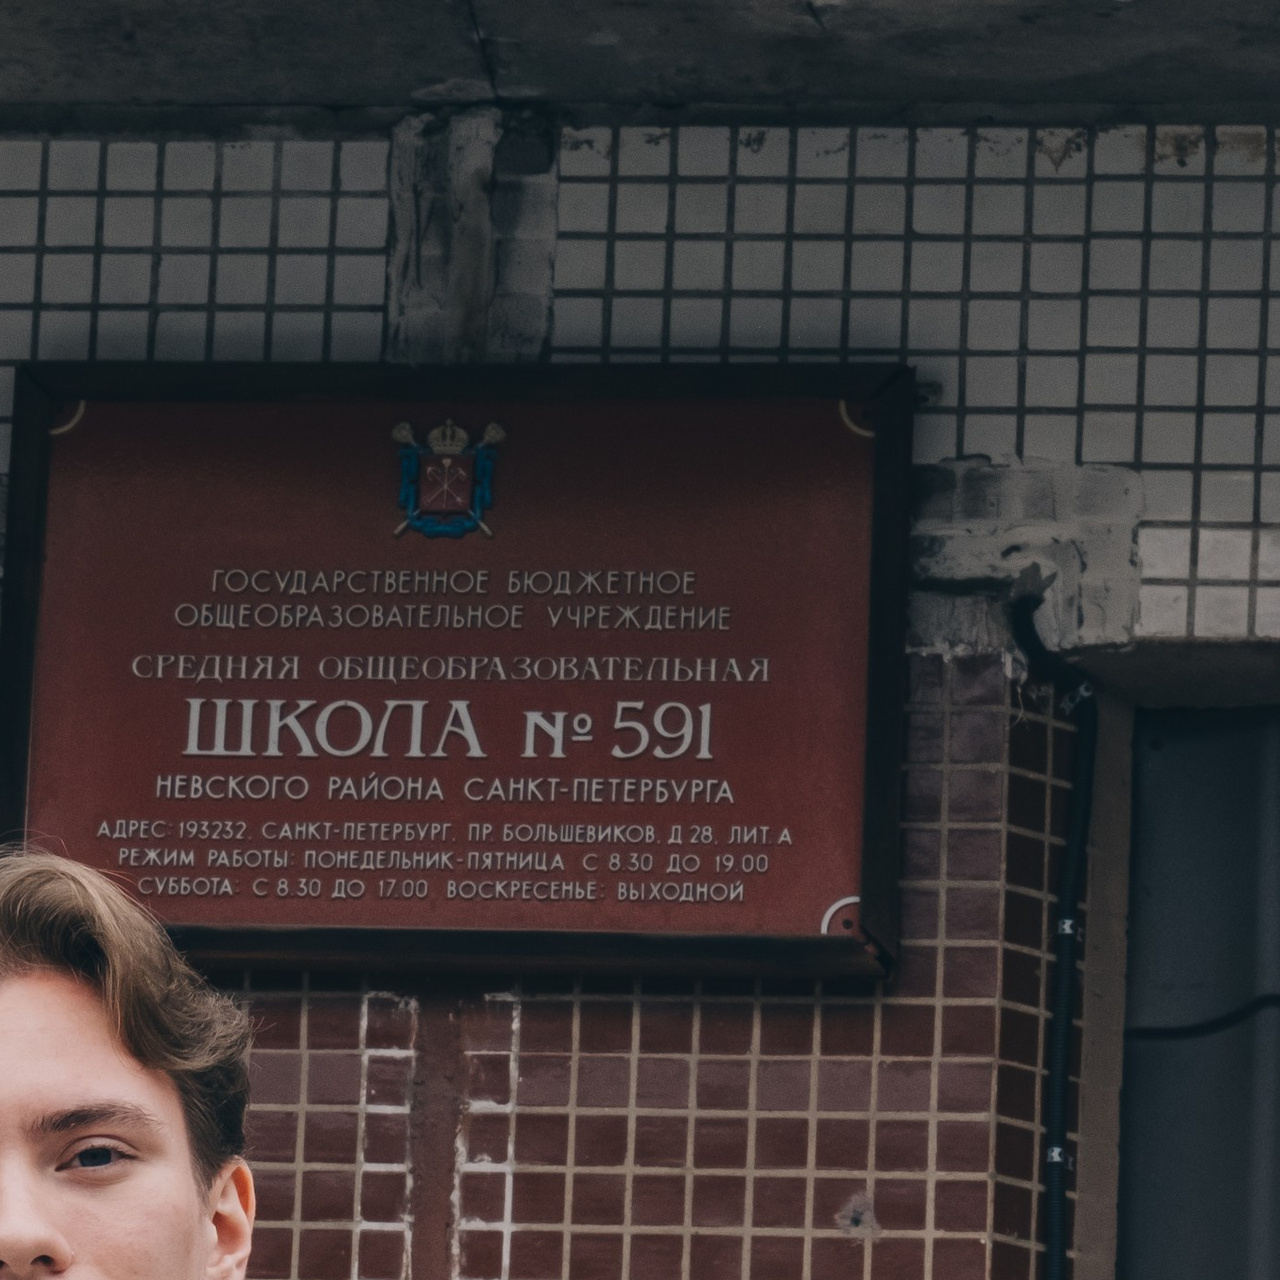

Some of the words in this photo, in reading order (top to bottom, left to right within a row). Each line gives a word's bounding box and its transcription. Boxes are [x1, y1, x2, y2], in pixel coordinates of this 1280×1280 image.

[211, 569, 489, 595] ГОСУДАРСТВЕННОЕ
[507, 570, 696, 595] БЮДЖЕТНОЕ
[175, 603, 524, 630] ОБЩЕОБРАЗОВАТЕЛЬНОЕ
[547, 604, 731, 631] УЧРЕЖДЕНИЕ
[131, 655, 300, 684] СРЕДНЯЯ
[318, 656, 771, 684] ОБЩЕОБРАЗОВАТЕЛЬНАЯ
[182, 698, 488, 758] ШКОЛА
[520, 711, 594, 759] №
[611, 701, 714, 760] 591
[155, 775, 310, 800] НЕВСКОГО
[327, 772, 444, 800] РАЙОНА
[463, 777, 735, 804] САНКТ-ПЕТЕРБУРГА
[777, 826, 793, 845] А
[118, 848, 195, 867] РЕЖИМ
[207, 849, 295, 869] РАБОТЫ:
[304, 850, 565, 872] ПОНЕДЕЛЬНИК-ПЯТНИЦА
[582, 853, 599, 872] С
[608, 853, 654, 872] 8.30
[666, 854, 700, 874] ДО
[715, 854, 769, 873] 19.00
[137, 877, 239, 896] СУББОТА:
[252, 878, 268, 897] С
[276, 878, 322, 897] 8.30
[331, 879, 365, 899] ДО
[379, 880, 428, 899] 17.00
[446, 880, 605, 900] ВОСКРЕСЕНЬЕ:
[617, 879, 745, 902] ВЫХОДНОЙ
